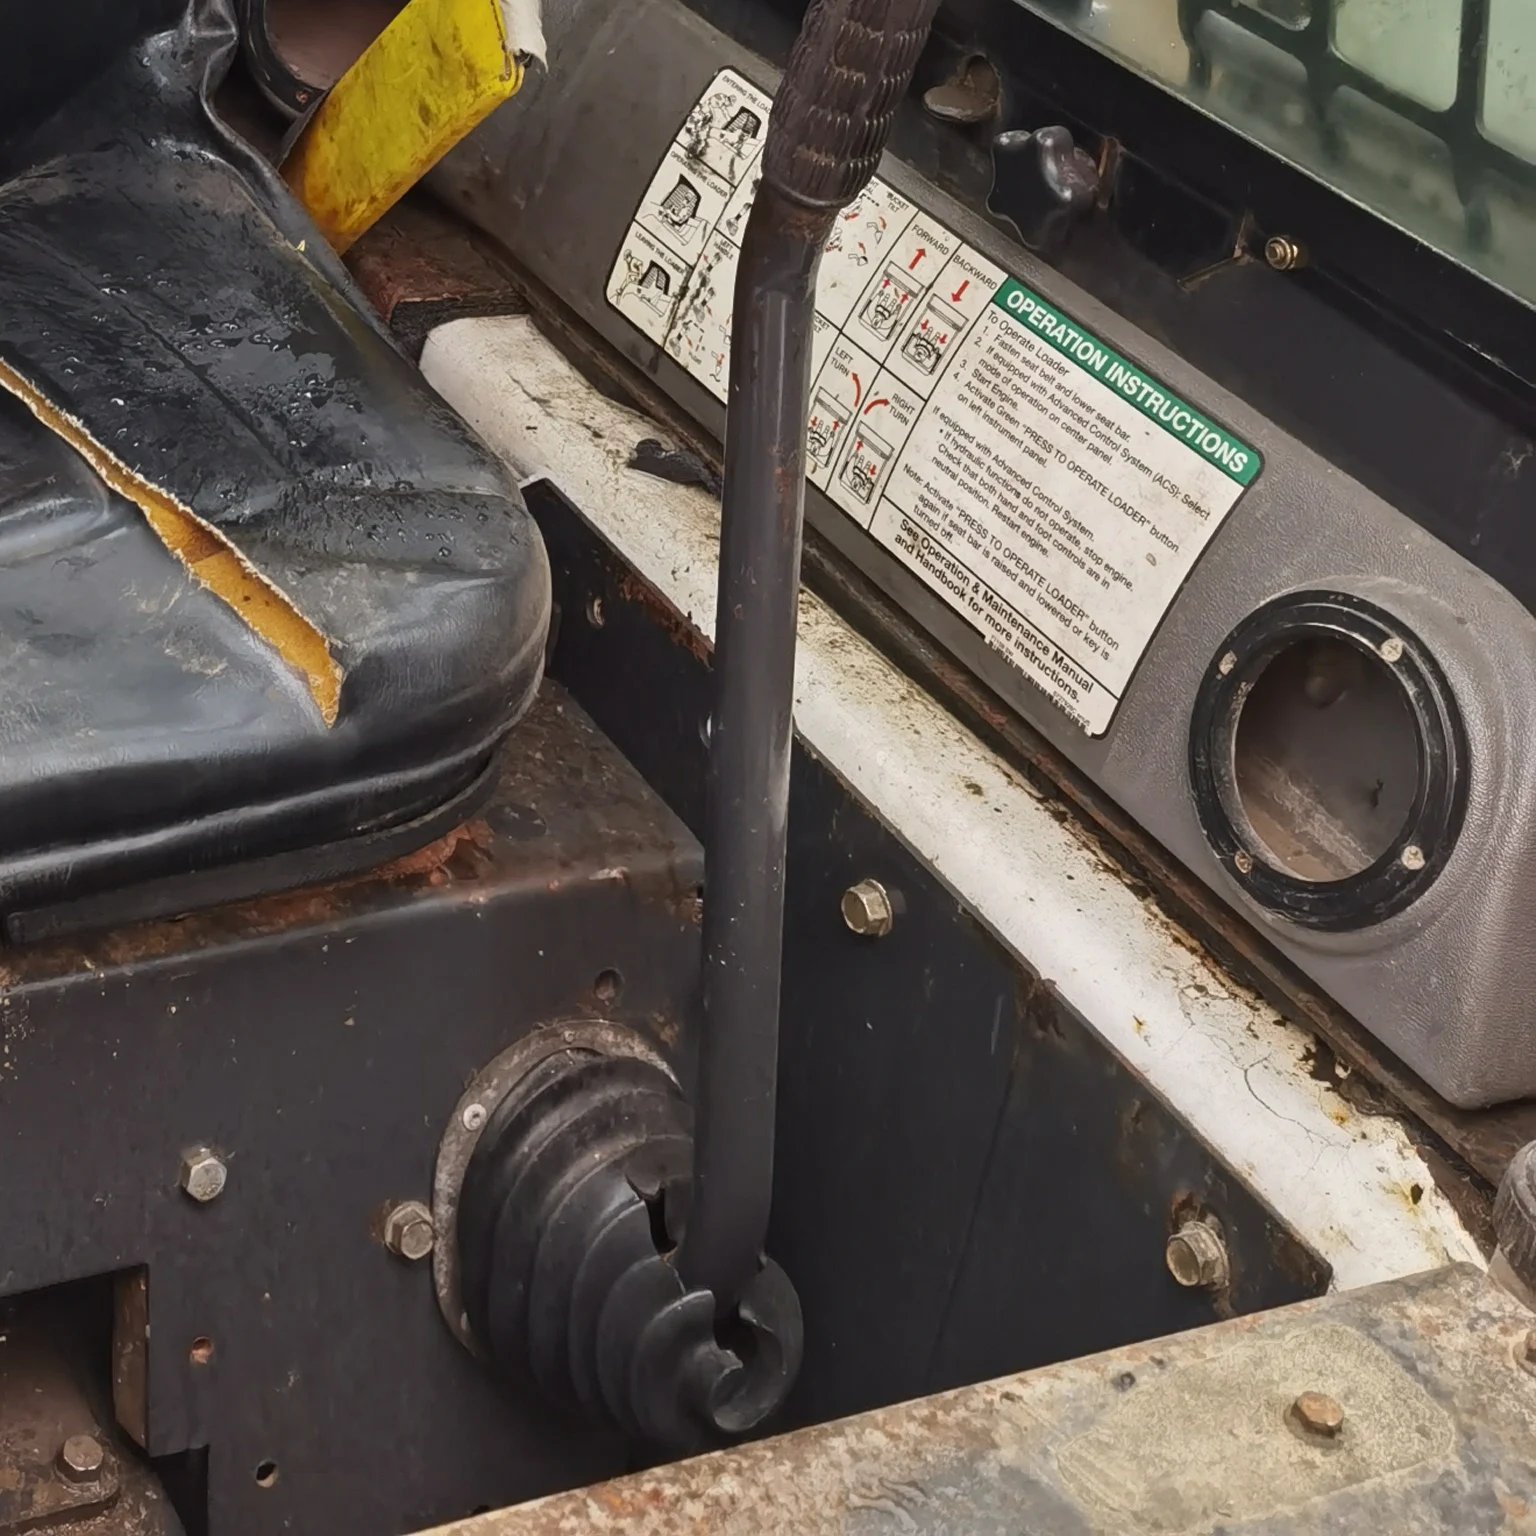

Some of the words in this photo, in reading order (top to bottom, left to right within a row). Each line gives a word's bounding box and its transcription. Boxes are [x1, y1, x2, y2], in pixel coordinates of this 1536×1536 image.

[722, 75, 748, 97] ENTERING
[747, 93, 758, 105] THE
[706, 181, 728, 199] LOADER
[635, 231, 656, 252] LEAVING
[654, 247, 665, 259] THE
[665, 255, 685, 275] LOADER
[713, 242, 734, 260] HANDLE
[720, 239, 734, 251] LEFT
[911, 224, 950, 256] FORWARD
[952, 254, 998, 291] BACKWARD
[830, 357, 850, 378] TURN
[834, 346, 854, 364] LEFT
[986, 309, 999, 325] To
[997, 318, 1036, 353] Operate
[1034, 346, 1071, 377] Loader
[888, 405, 910, 427] TURN
[891, 393, 916, 416] RIGHT
[958, 358, 968, 370] 3.
[970, 367, 992, 388] Start
[989, 382, 1020, 412] Engine.
[977, 357, 1002, 379] mode
[1000, 374, 1012, 386] of
[1009, 382, 1049, 416] operation
[1047, 411, 1060, 424] on
[1059, 420, 1088, 445] center
[1085, 440, 1114, 466] panel.
[982, 325, 990, 336] 1.
[992, 333, 1021, 359] Fasten
[1019, 355, 1039, 373] seat
[1037, 367, 1056, 385] belt
[1054, 380, 1073, 398] and
[1070, 392, 1097, 415] lower
[1094, 411, 1115, 430] seat
[1113, 424, 1132, 443] bar.
[1005, 288, 1109, 372] OPERATION
[1103, 360, 1249, 474] INSTRUCTIONS
[952, 370, 961, 381] 4.
[963, 379, 996, 409] Activate
[995, 404, 1021, 428] Green
[1052, 448, 1068, 465] TO
[1065, 459, 1109, 497] OPERATE
[1148, 524, 1180, 553] button
[956, 392, 969, 405] on
[967, 399, 983, 415] left
[981, 410, 1024, 449] instrument
[1021, 444, 1048, 469] panel.
[973, 335, 983, 348] 2.
[985, 344, 995, 355] If
[991, 351, 1031, 384] equipped
[1029, 378, 1048, 397] with
[1046, 392, 1090, 428] Advanced
[1087, 423, 1122, 452] Control
[1119, 446, 1154, 478] System
[1180, 492, 1211, 521] Select
[930, 455, 959, 481] neutral
[956, 477, 990, 509] position.
[990, 503, 1021, 533] Restart
[1019, 529, 1050, 559] engine.
[932, 404, 941, 415] If
[938, 411, 976, 444] equipped
[974, 439, 992, 458] with
[991, 453, 1033, 490] Advanced
[1031, 484, 1063, 514] Control
[1060, 509, 1096, 543] System.
[912, 503, 941, 531] turned
[939, 526, 954, 544] off.
[937, 442, 963, 468] Check
[961, 463, 979, 481] that
[977, 476, 997, 496] both
[996, 491, 1019, 514] hand
[1017, 509, 1035, 527] and
[1033, 522, 1053, 542] foot
[1051, 537, 1087, 570] controls
[1085, 566, 1101, 582] are
[1100, 577, 1110, 590] in
[943, 430, 952, 441] If
[949, 436, 986, 470] hydraulic
[984, 464, 1022, 499] functions
[1020, 495, 1034, 509] do
[1033, 505, 1049, 521] not
[1047, 517, 1082, 550] operate,
[1082, 545, 1104, 567] stop
[1102, 561, 1134, 593] engine.
[902, 462, 924, 485] Note:
[922, 480, 954, 511] Activate
[987, 533, 1003, 551] TO
[1001, 546, 1046, 588] OPERATE
[1087, 619, 1120, 651] button
[917, 493, 941, 517] again
[940, 511, 949, 522] if
[947, 518, 967, 538] seat
[965, 533, 982, 551] bar
[981, 546, 991, 559] is
[990, 554, 1019, 582] raised
[1017, 577, 1037, 597] and
[1035, 592, 1073, 628] lowered
[1071, 624, 1083, 637] or
[1081, 631, 1101, 654] key
[1099, 647, 1110, 661] is
[893, 532, 916, 555] and
[913, 548, 968, 602] Handbook
[966, 595, 985, 616] for
[983, 612, 1013, 642] more
[1012, 636, 1081, 703] instructions.
[899, 517, 920, 542] See
[919, 536, 971, 587] Operation
[970, 580, 981, 595] &
[980, 589, 1051, 656] Maintenance
[1050, 650, 1094, 694] Manual
